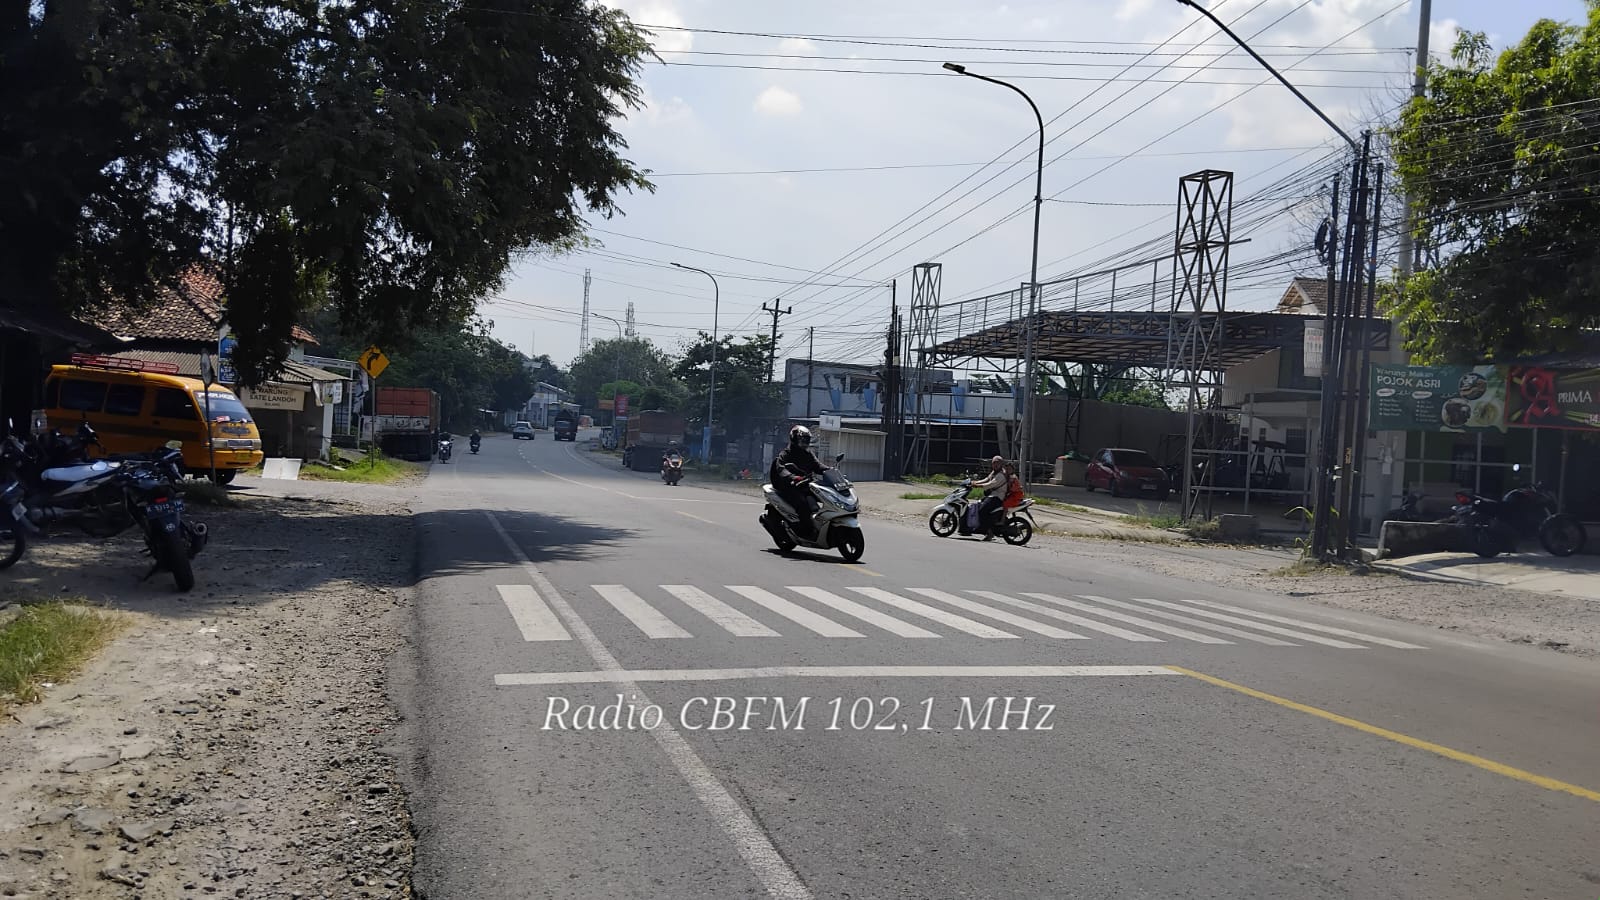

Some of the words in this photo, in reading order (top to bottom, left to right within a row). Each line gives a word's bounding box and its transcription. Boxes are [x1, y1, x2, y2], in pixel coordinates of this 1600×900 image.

[1376, 375, 1414, 387] POJOK
[1415, 379, 1441, 388] ASRI
[1558, 389, 1592, 403] PRIMA
